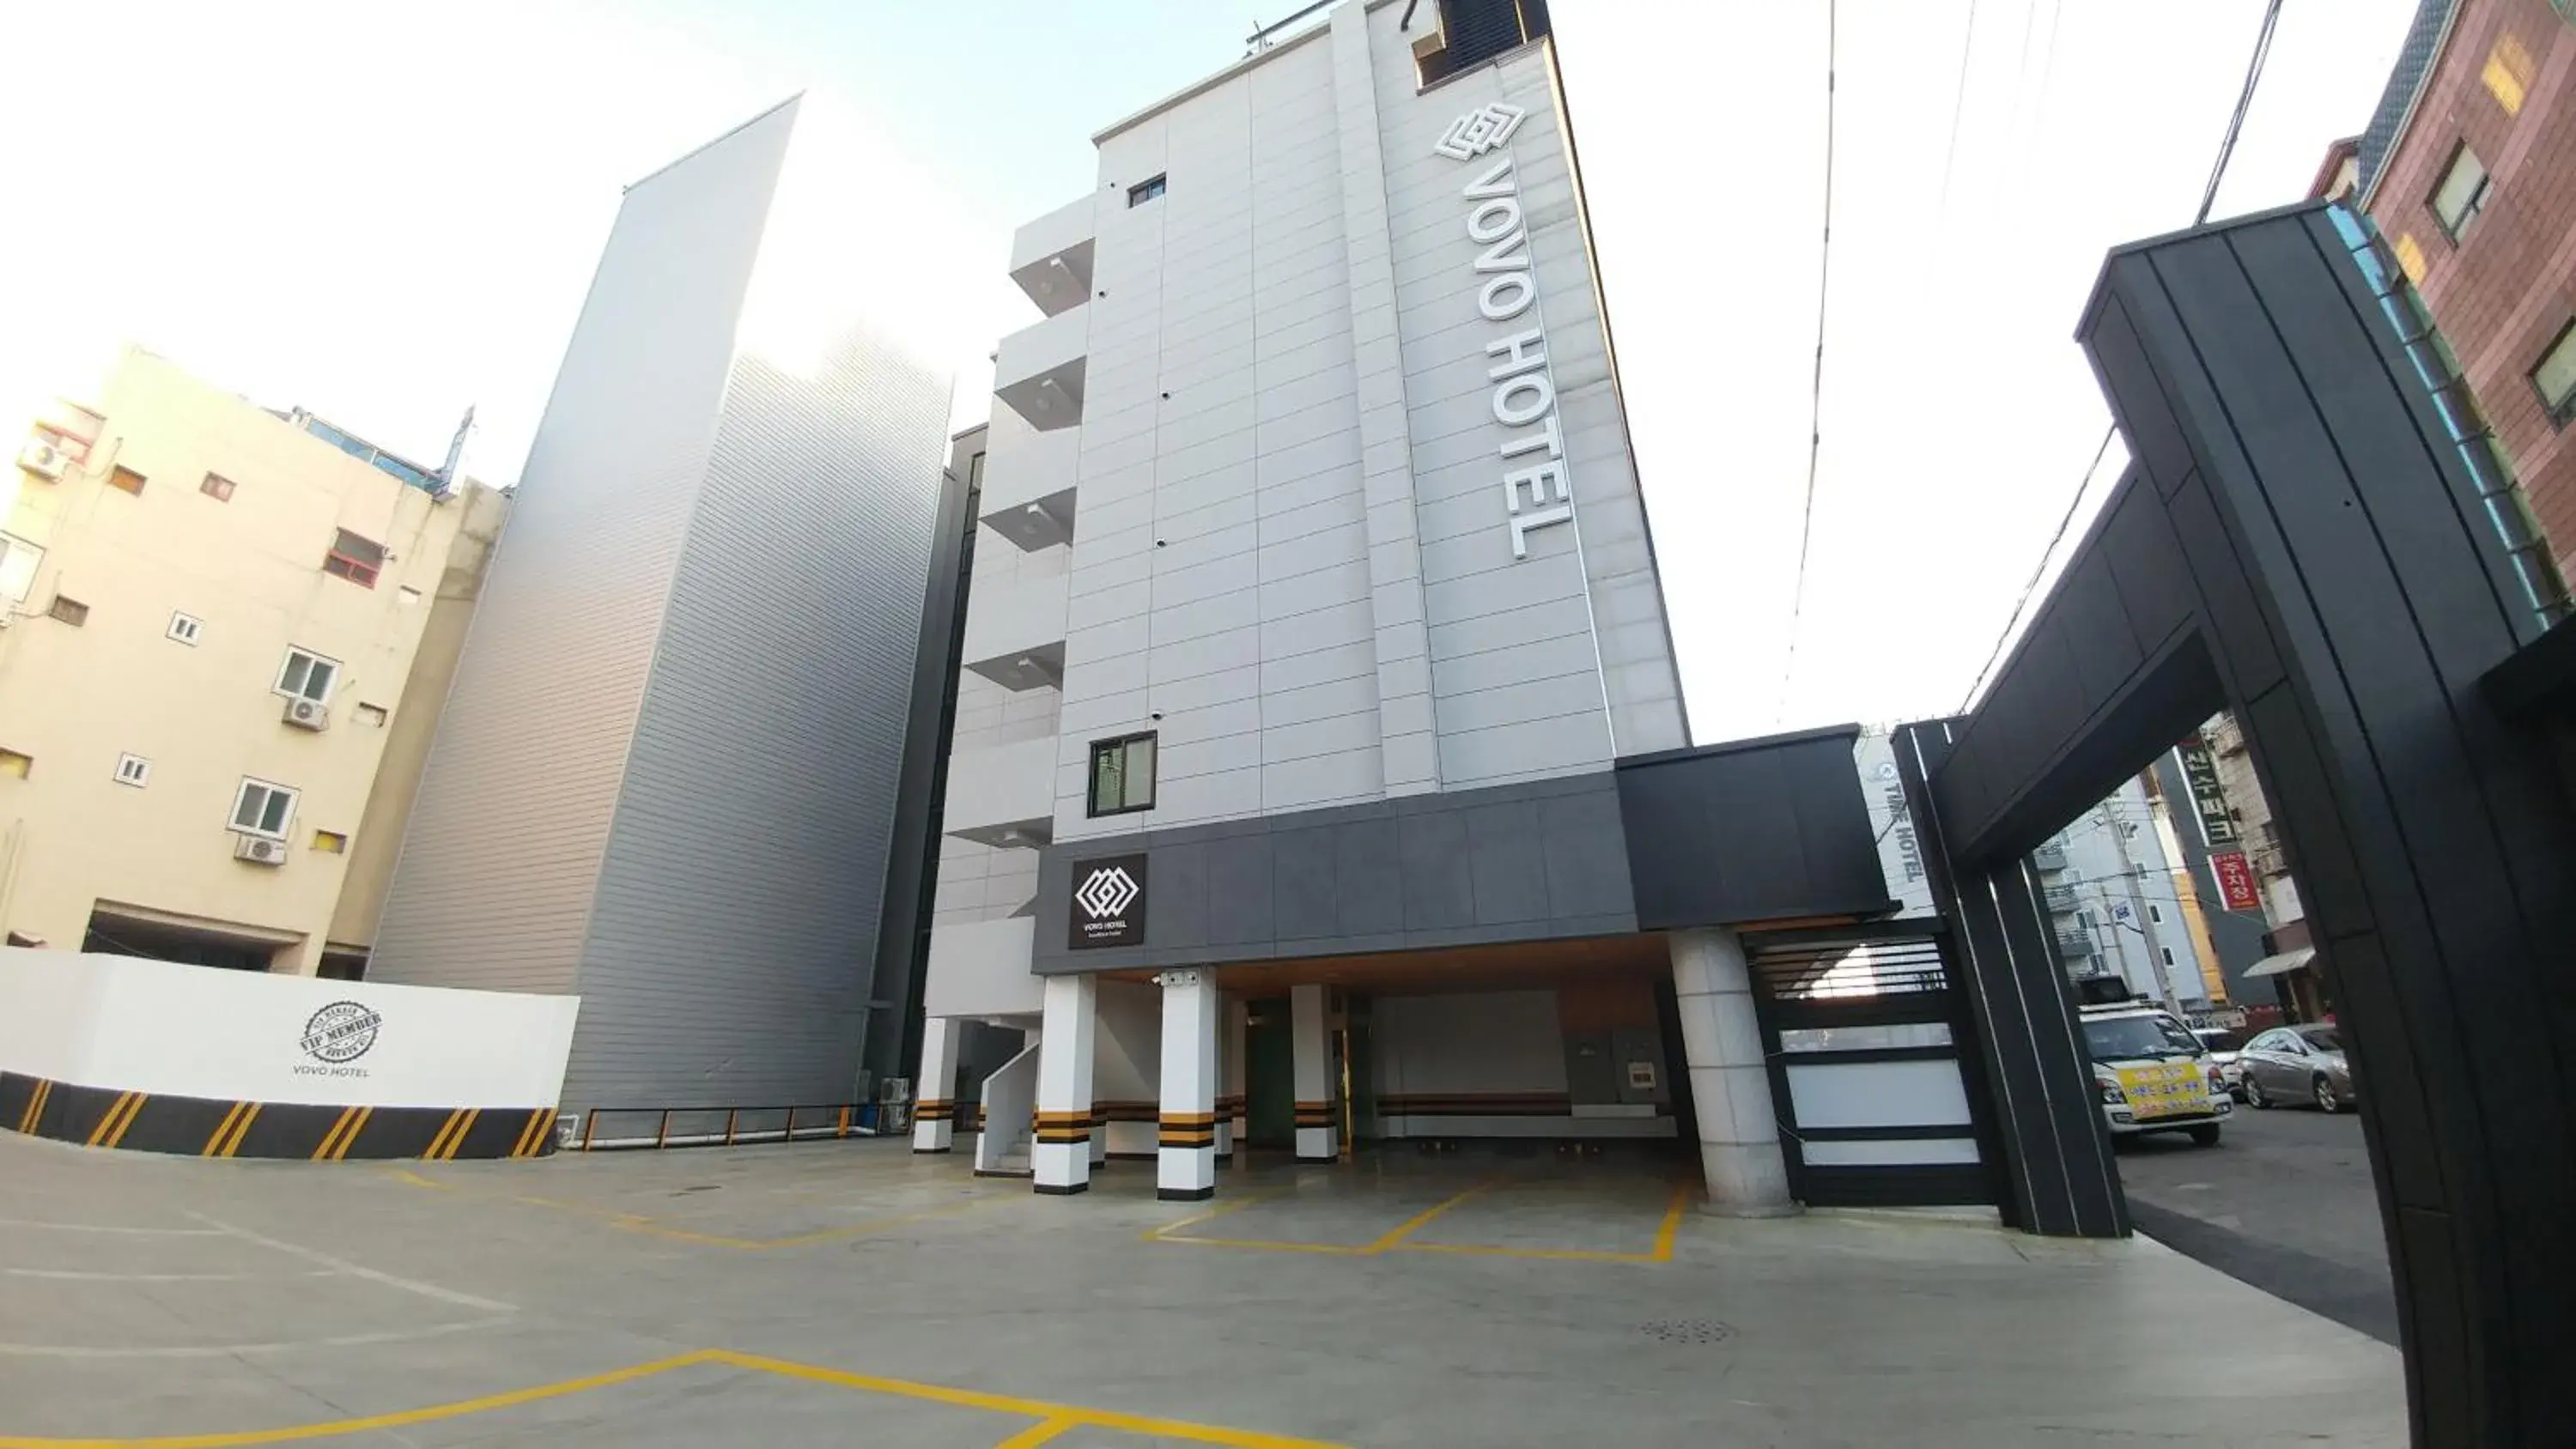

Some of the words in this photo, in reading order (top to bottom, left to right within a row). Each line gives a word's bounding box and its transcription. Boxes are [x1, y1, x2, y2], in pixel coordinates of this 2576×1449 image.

[1463, 157, 1535, 321] VOVO
[1486, 328, 1573, 560] HOTEL
[1895, 827, 1924, 883] HOTEL
[301, 1035, 323, 1051] VIP
[325, 1013, 382, 1040] MEMBER
[293, 1065, 328, 1076] VOVO
[330, 1067, 371, 1077] HOTEL
